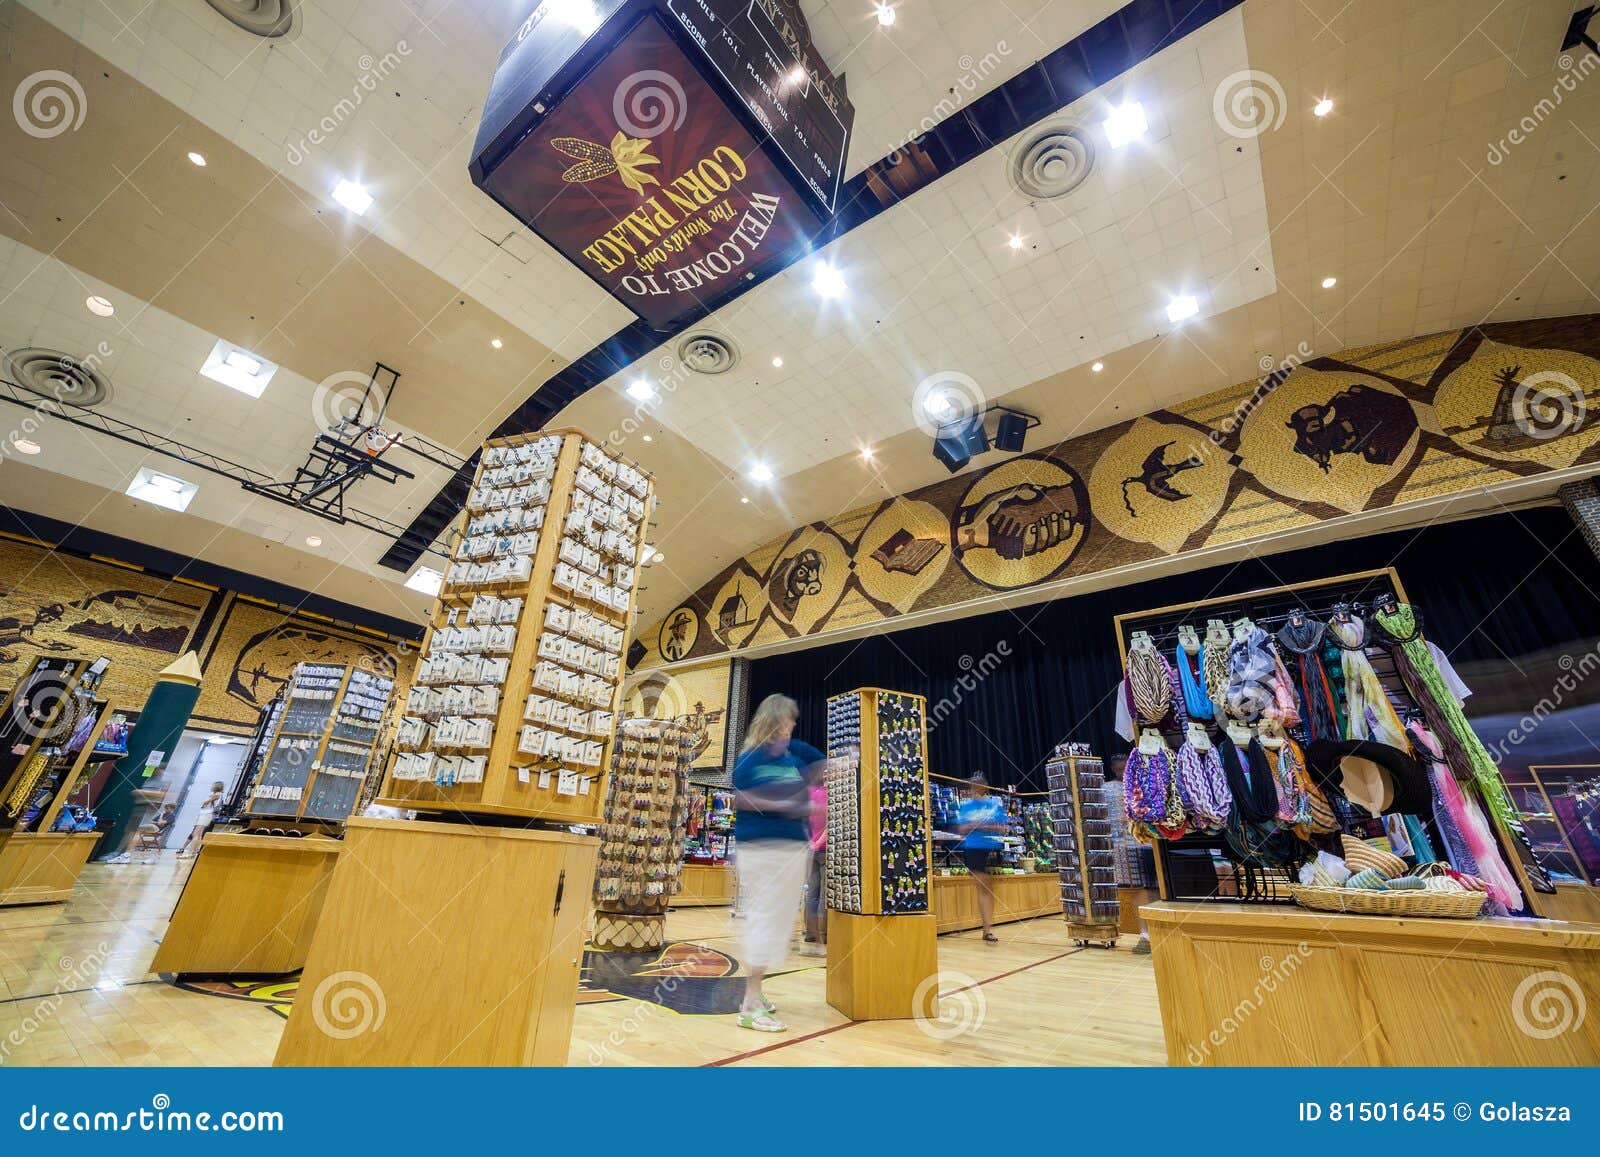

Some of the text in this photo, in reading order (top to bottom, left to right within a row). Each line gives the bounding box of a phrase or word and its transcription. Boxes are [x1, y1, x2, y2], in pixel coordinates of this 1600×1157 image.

[680, 12, 707, 48] SCORE
[746, 62, 772, 100] PLAYER
[813, 152, 832, 178] FOULS
[809, 176, 829, 202] SCORE
[582, 146, 747, 274] CORN PALACE
[708, 199, 738, 223] The
[621, 192, 780, 296] WELCOME TO
[634, 247, 668, 272] Only
